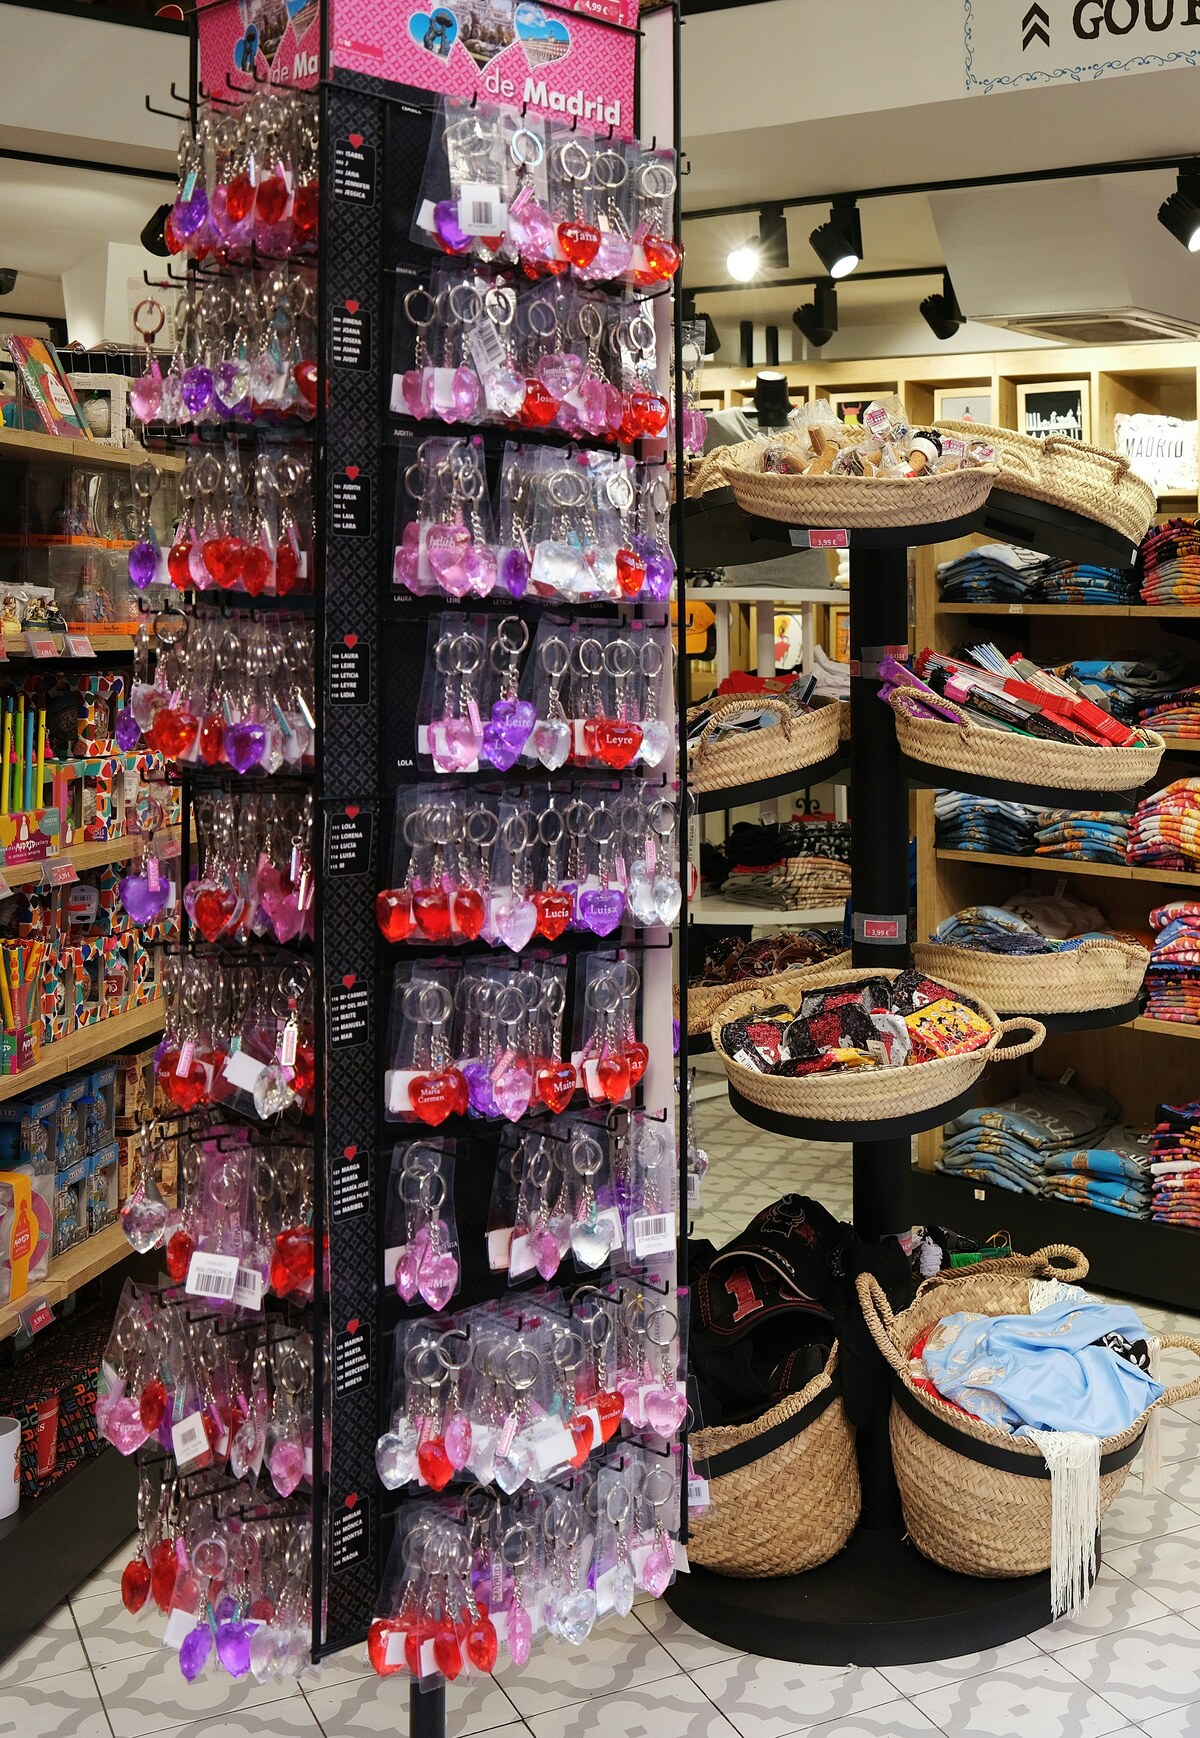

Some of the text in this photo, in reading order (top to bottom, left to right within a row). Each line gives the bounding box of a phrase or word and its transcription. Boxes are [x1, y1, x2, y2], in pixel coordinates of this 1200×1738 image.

[486, 70, 621, 126] de Madrid
[345, 151, 364, 161] ISABEL
[345, 180, 370, 190] JENNIFER
[344, 189, 366, 199] JESSICA
[573, 230, 598, 243] Jana
[342, 317, 362, 326] JIMENA
[342, 327, 360, 335] JOANA
[342, 337, 361, 345] JOSEFA
[1126, 437, 1184, 458] MADRID
[506, 716, 532, 728] Leire
[606, 734, 633, 746] Leyre
[340, 852, 356, 860] LUISA
[545, 908, 569, 919] Lucía
[590, 904, 618, 915] Luisa
[553, 1079, 576, 1093] Maite
[418, 1094, 445, 1103] Carmen
[344, 1347, 361, 1359] MARTA
[345, 1364, 369, 1379] MERCEDES
[342, 1529, 363, 1543] MONTSE
[342, 1551, 359, 1563] NADIA
